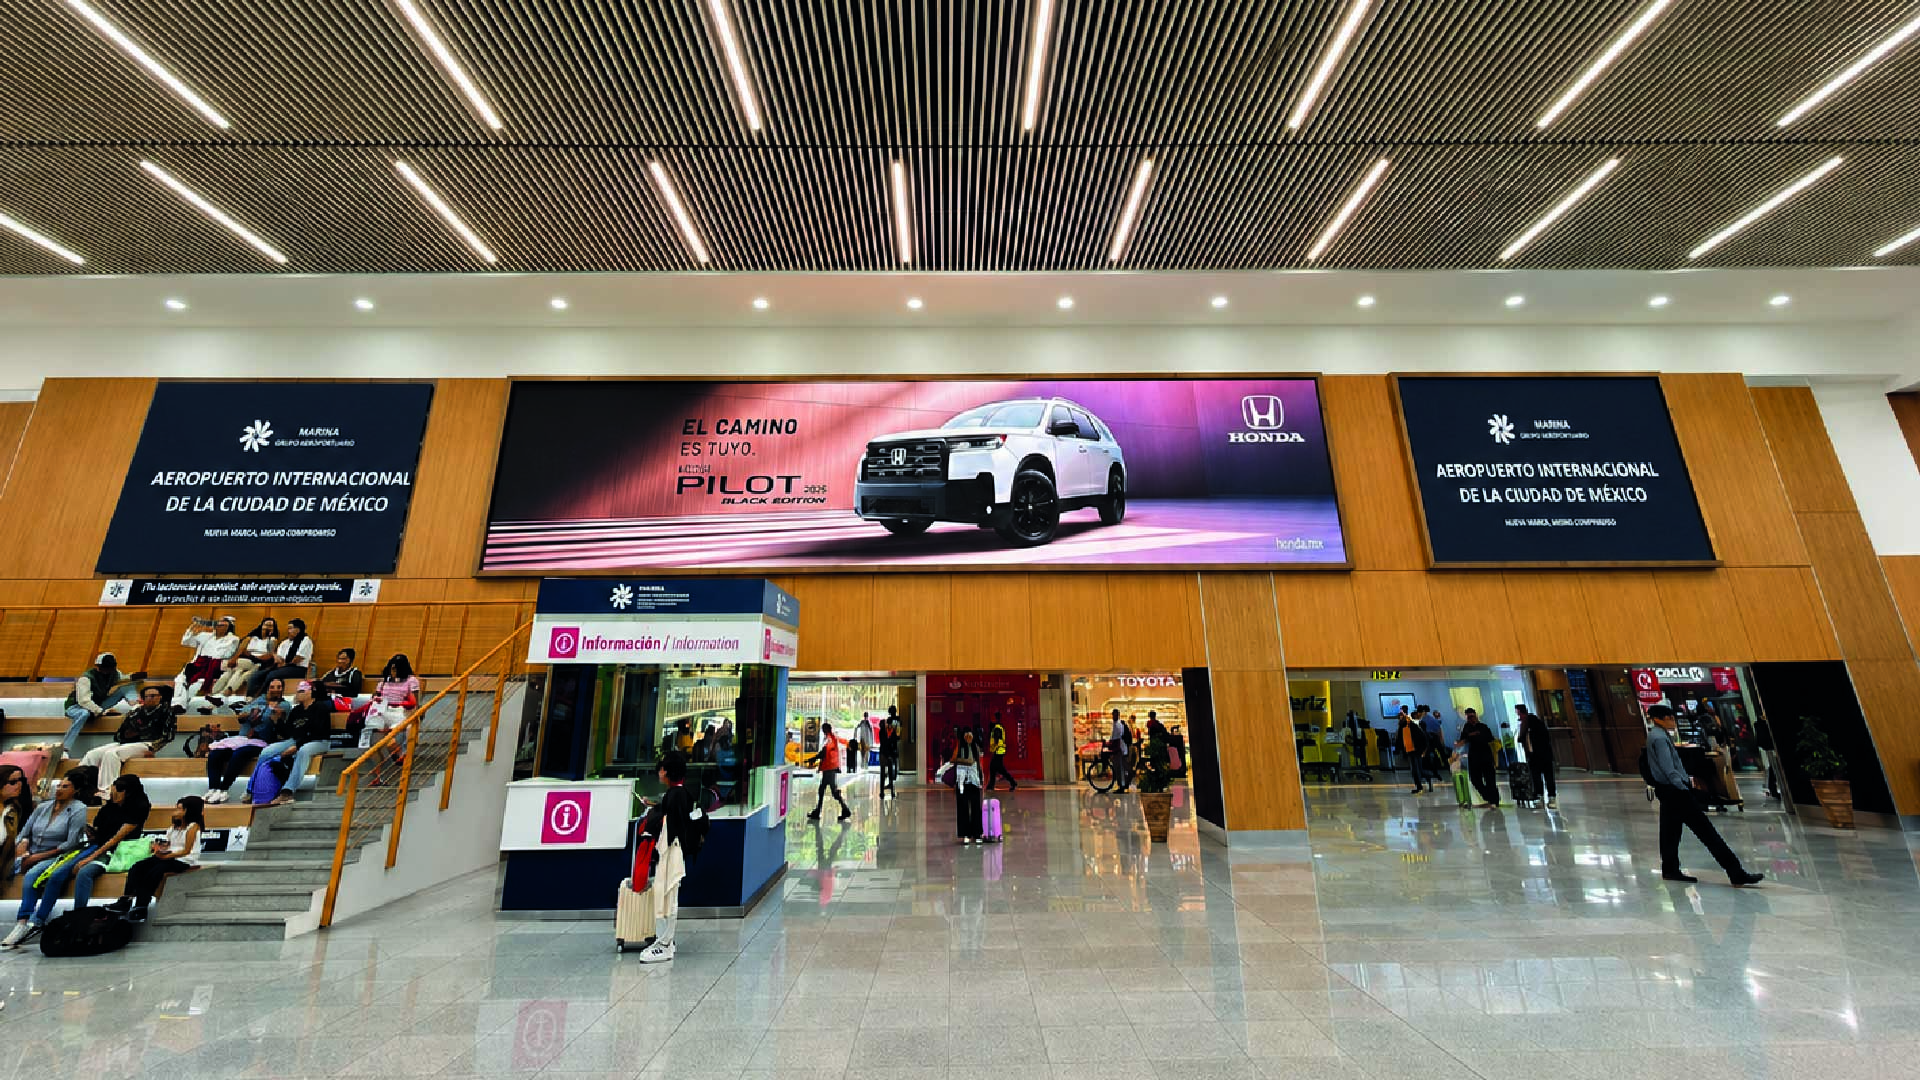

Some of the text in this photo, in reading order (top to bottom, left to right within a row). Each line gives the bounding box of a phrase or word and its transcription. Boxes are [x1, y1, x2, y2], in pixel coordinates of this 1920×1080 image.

[682, 418, 798, 436] EL CAMINO
[1228, 432, 1305, 443] HONDA
[680, 441, 756, 457] ES TUYO.
[1436, 461, 1660, 478] AEROPUERTO INTERNACIONAL
[151, 470, 412, 487] AEROPUERTO INTERNACIONAL
[676, 475, 802, 495] PILOT
[720, 497, 827, 505] BLACK EDITION
[1459, 483, 1648, 503] DE LA CIUDAD DE MÉXICO
[165, 492, 389, 512] DE LA CIUDAD DE MÉXICO
[581, 635, 661, 650] Información
[671, 635, 739, 651] Information
[1117, 676, 1176, 688] TOYOTA
